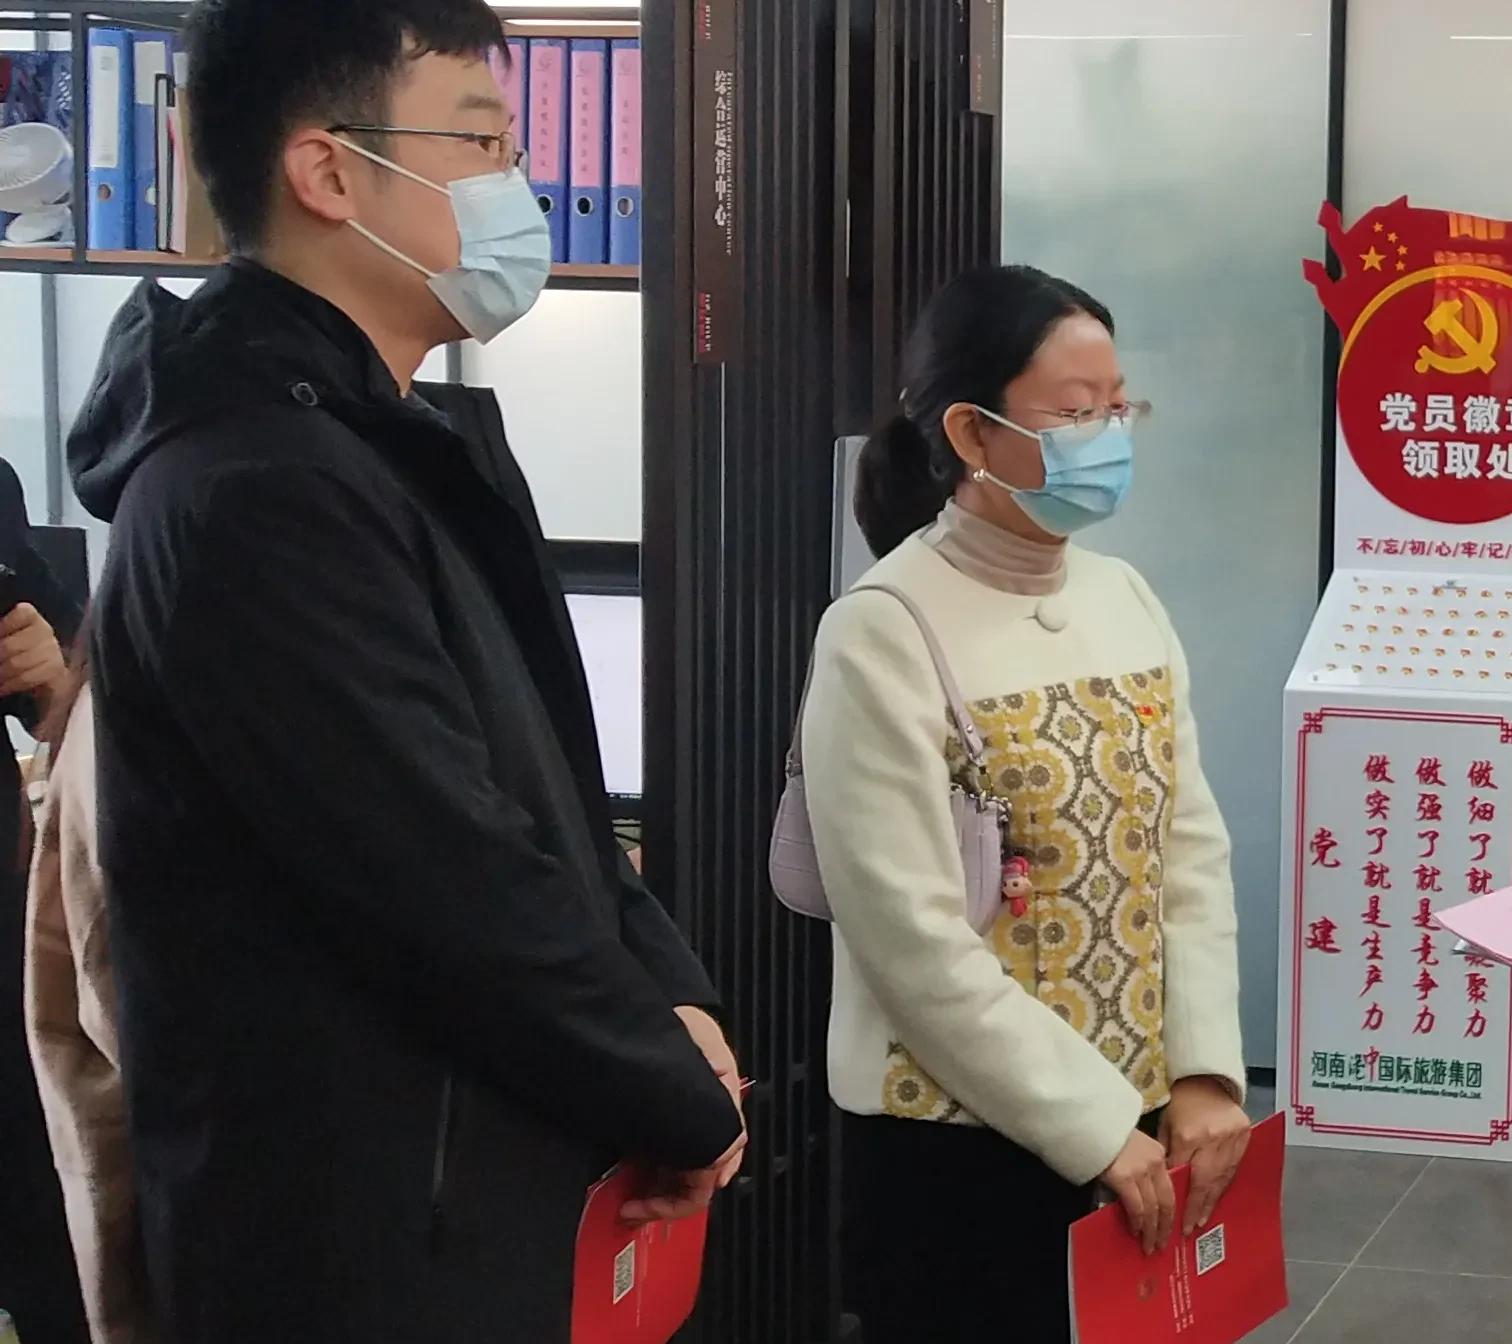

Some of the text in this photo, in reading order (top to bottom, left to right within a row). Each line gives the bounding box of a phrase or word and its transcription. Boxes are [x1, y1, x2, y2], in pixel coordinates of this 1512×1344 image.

[1303, 826, 1342, 955] 党建
[1358, 753, 1396, 1033] 做实了就是生产力
[1411, 755, 1447, 1036] 做强了就是竞争力
[1463, 759, 1499, 1040] 做细了就聚力
